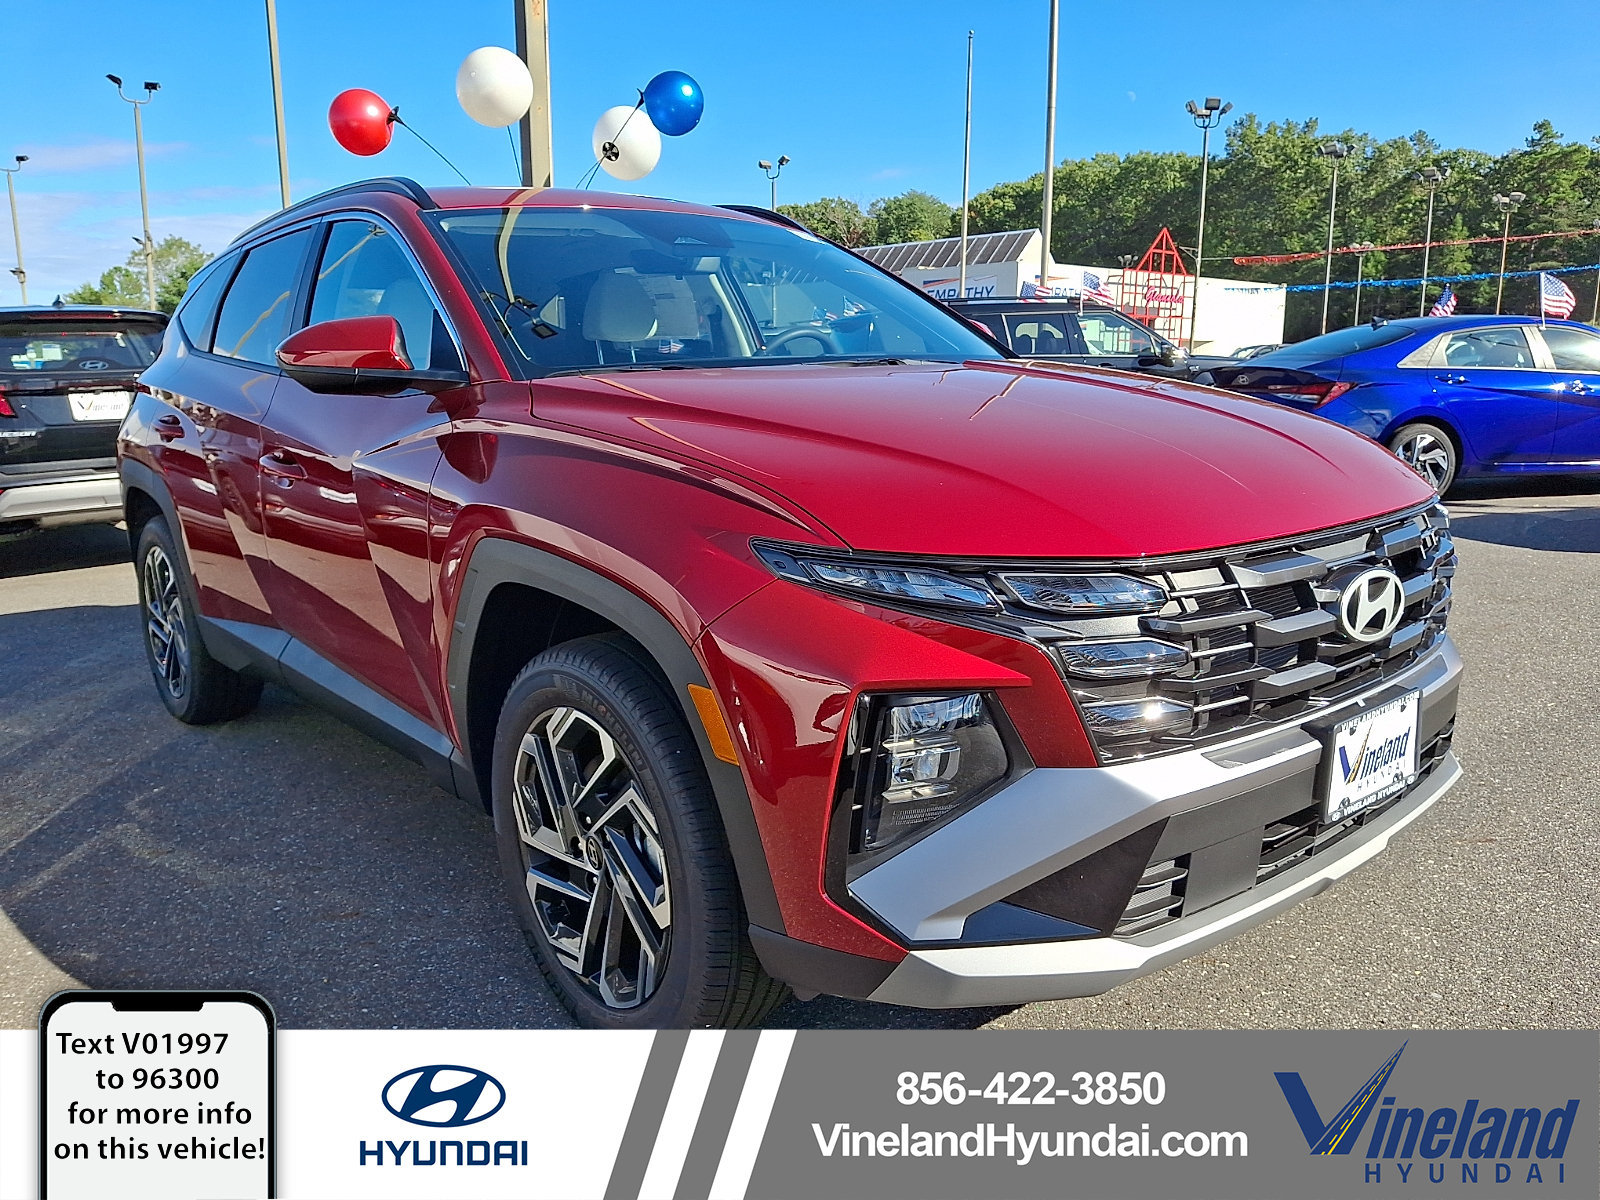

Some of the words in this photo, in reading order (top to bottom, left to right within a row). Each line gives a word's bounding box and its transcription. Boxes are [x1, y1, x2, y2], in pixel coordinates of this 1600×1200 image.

[1338, 717, 1411, 785] Vineland
[1343, 794, 1377, 816] VINELAND
[1377, 779, 1406, 801] HYUNDAI
